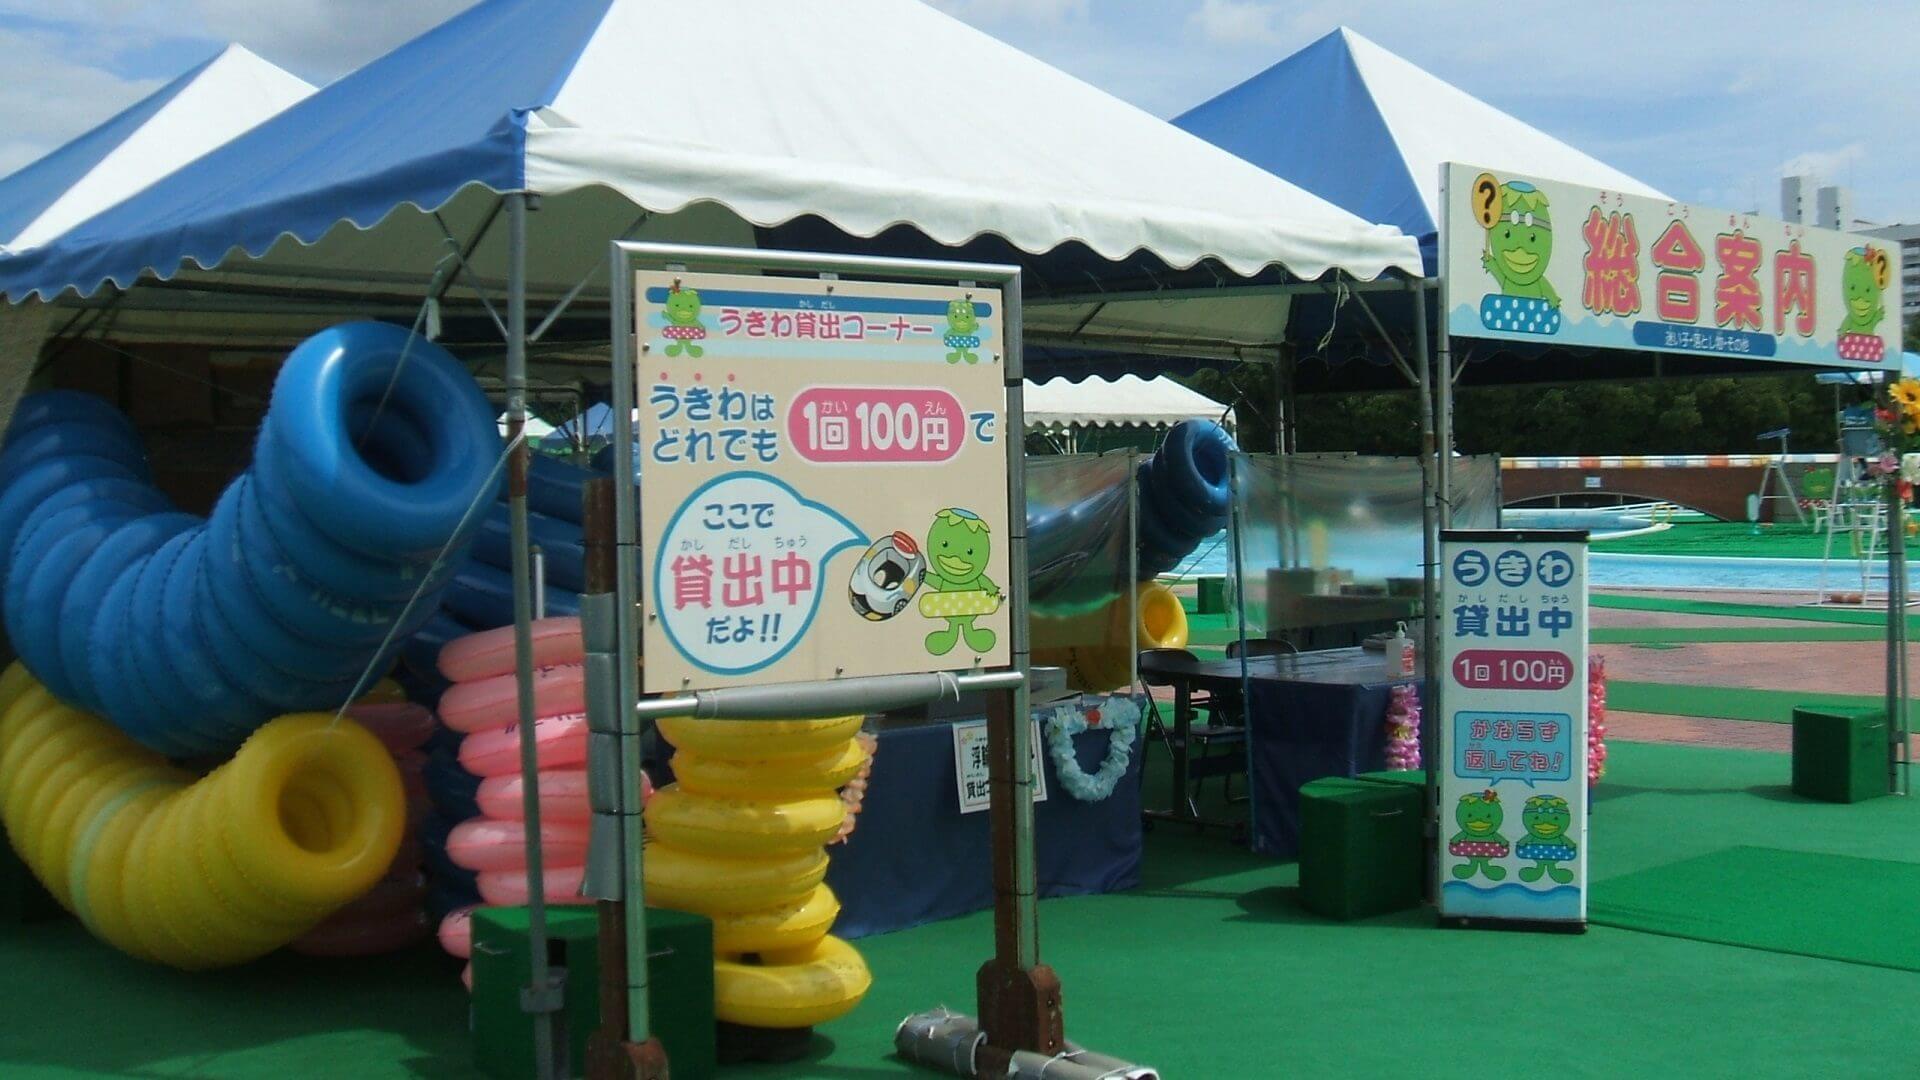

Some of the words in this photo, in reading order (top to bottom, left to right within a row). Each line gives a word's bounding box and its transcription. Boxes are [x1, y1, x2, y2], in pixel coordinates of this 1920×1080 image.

[1582, 205, 1818, 338] 総合案内
[720, 308, 933, 342] うきわ貸出コーナー
[650, 384, 775, 422] うきわは
[821, 401, 848, 414] かい
[924, 401, 946, 415] えん
[970, 412, 995, 442] で
[652, 428, 779, 463] どれでも
[702, 503, 774, 530] ここで
[680, 538, 704, 550] かし
[728, 537, 751, 550] だし
[774, 535, 808, 549] ちゅう
[670, 551, 812, 611] 貸出中
[1455, 552, 1573, 584] うきわ
[706, 613, 781, 645] だよ!!
[1453, 605, 1573, 638] 貸出中
[1465, 750, 1563, 772] 返してね!
